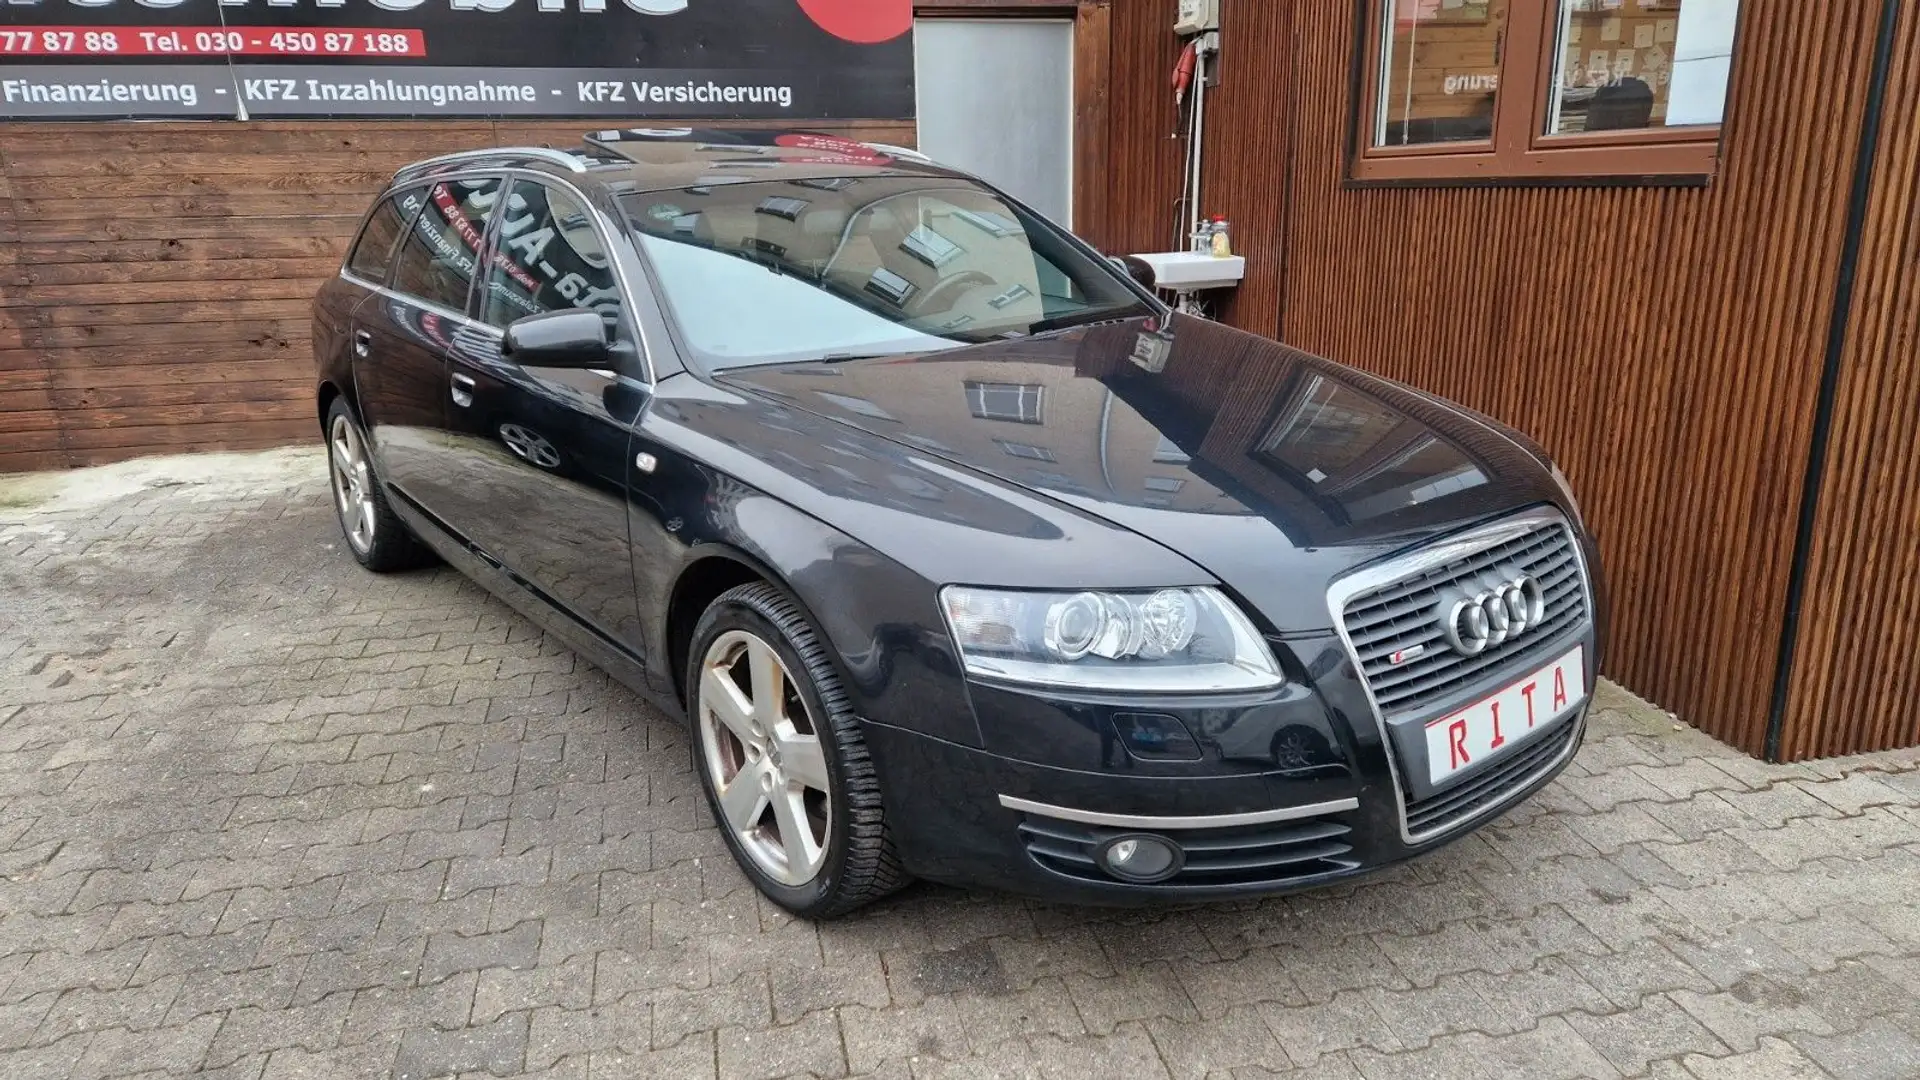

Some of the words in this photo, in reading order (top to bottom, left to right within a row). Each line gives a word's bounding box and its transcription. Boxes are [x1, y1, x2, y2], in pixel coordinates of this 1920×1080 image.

[0, 32, 33, 51] 77
[42, 31, 75, 52] 87
[84, 31, 118, 52] 88
[139, 31, 188, 52] Tel.
[195, 32, 244, 52] 030
[270, 32, 317, 52] 450
[324, 33, 354, 52] 87
[363, 33, 409, 53] 188
[2, 79, 198, 106] Finanzierung
[244, 79, 300, 101] KFZ
[306, 79, 536, 107] Inzahlungnahme
[577, 81, 625, 101] KFZ
[631, 81, 792, 107] Versicherung
[1447, 666, 1567, 770] RITA
